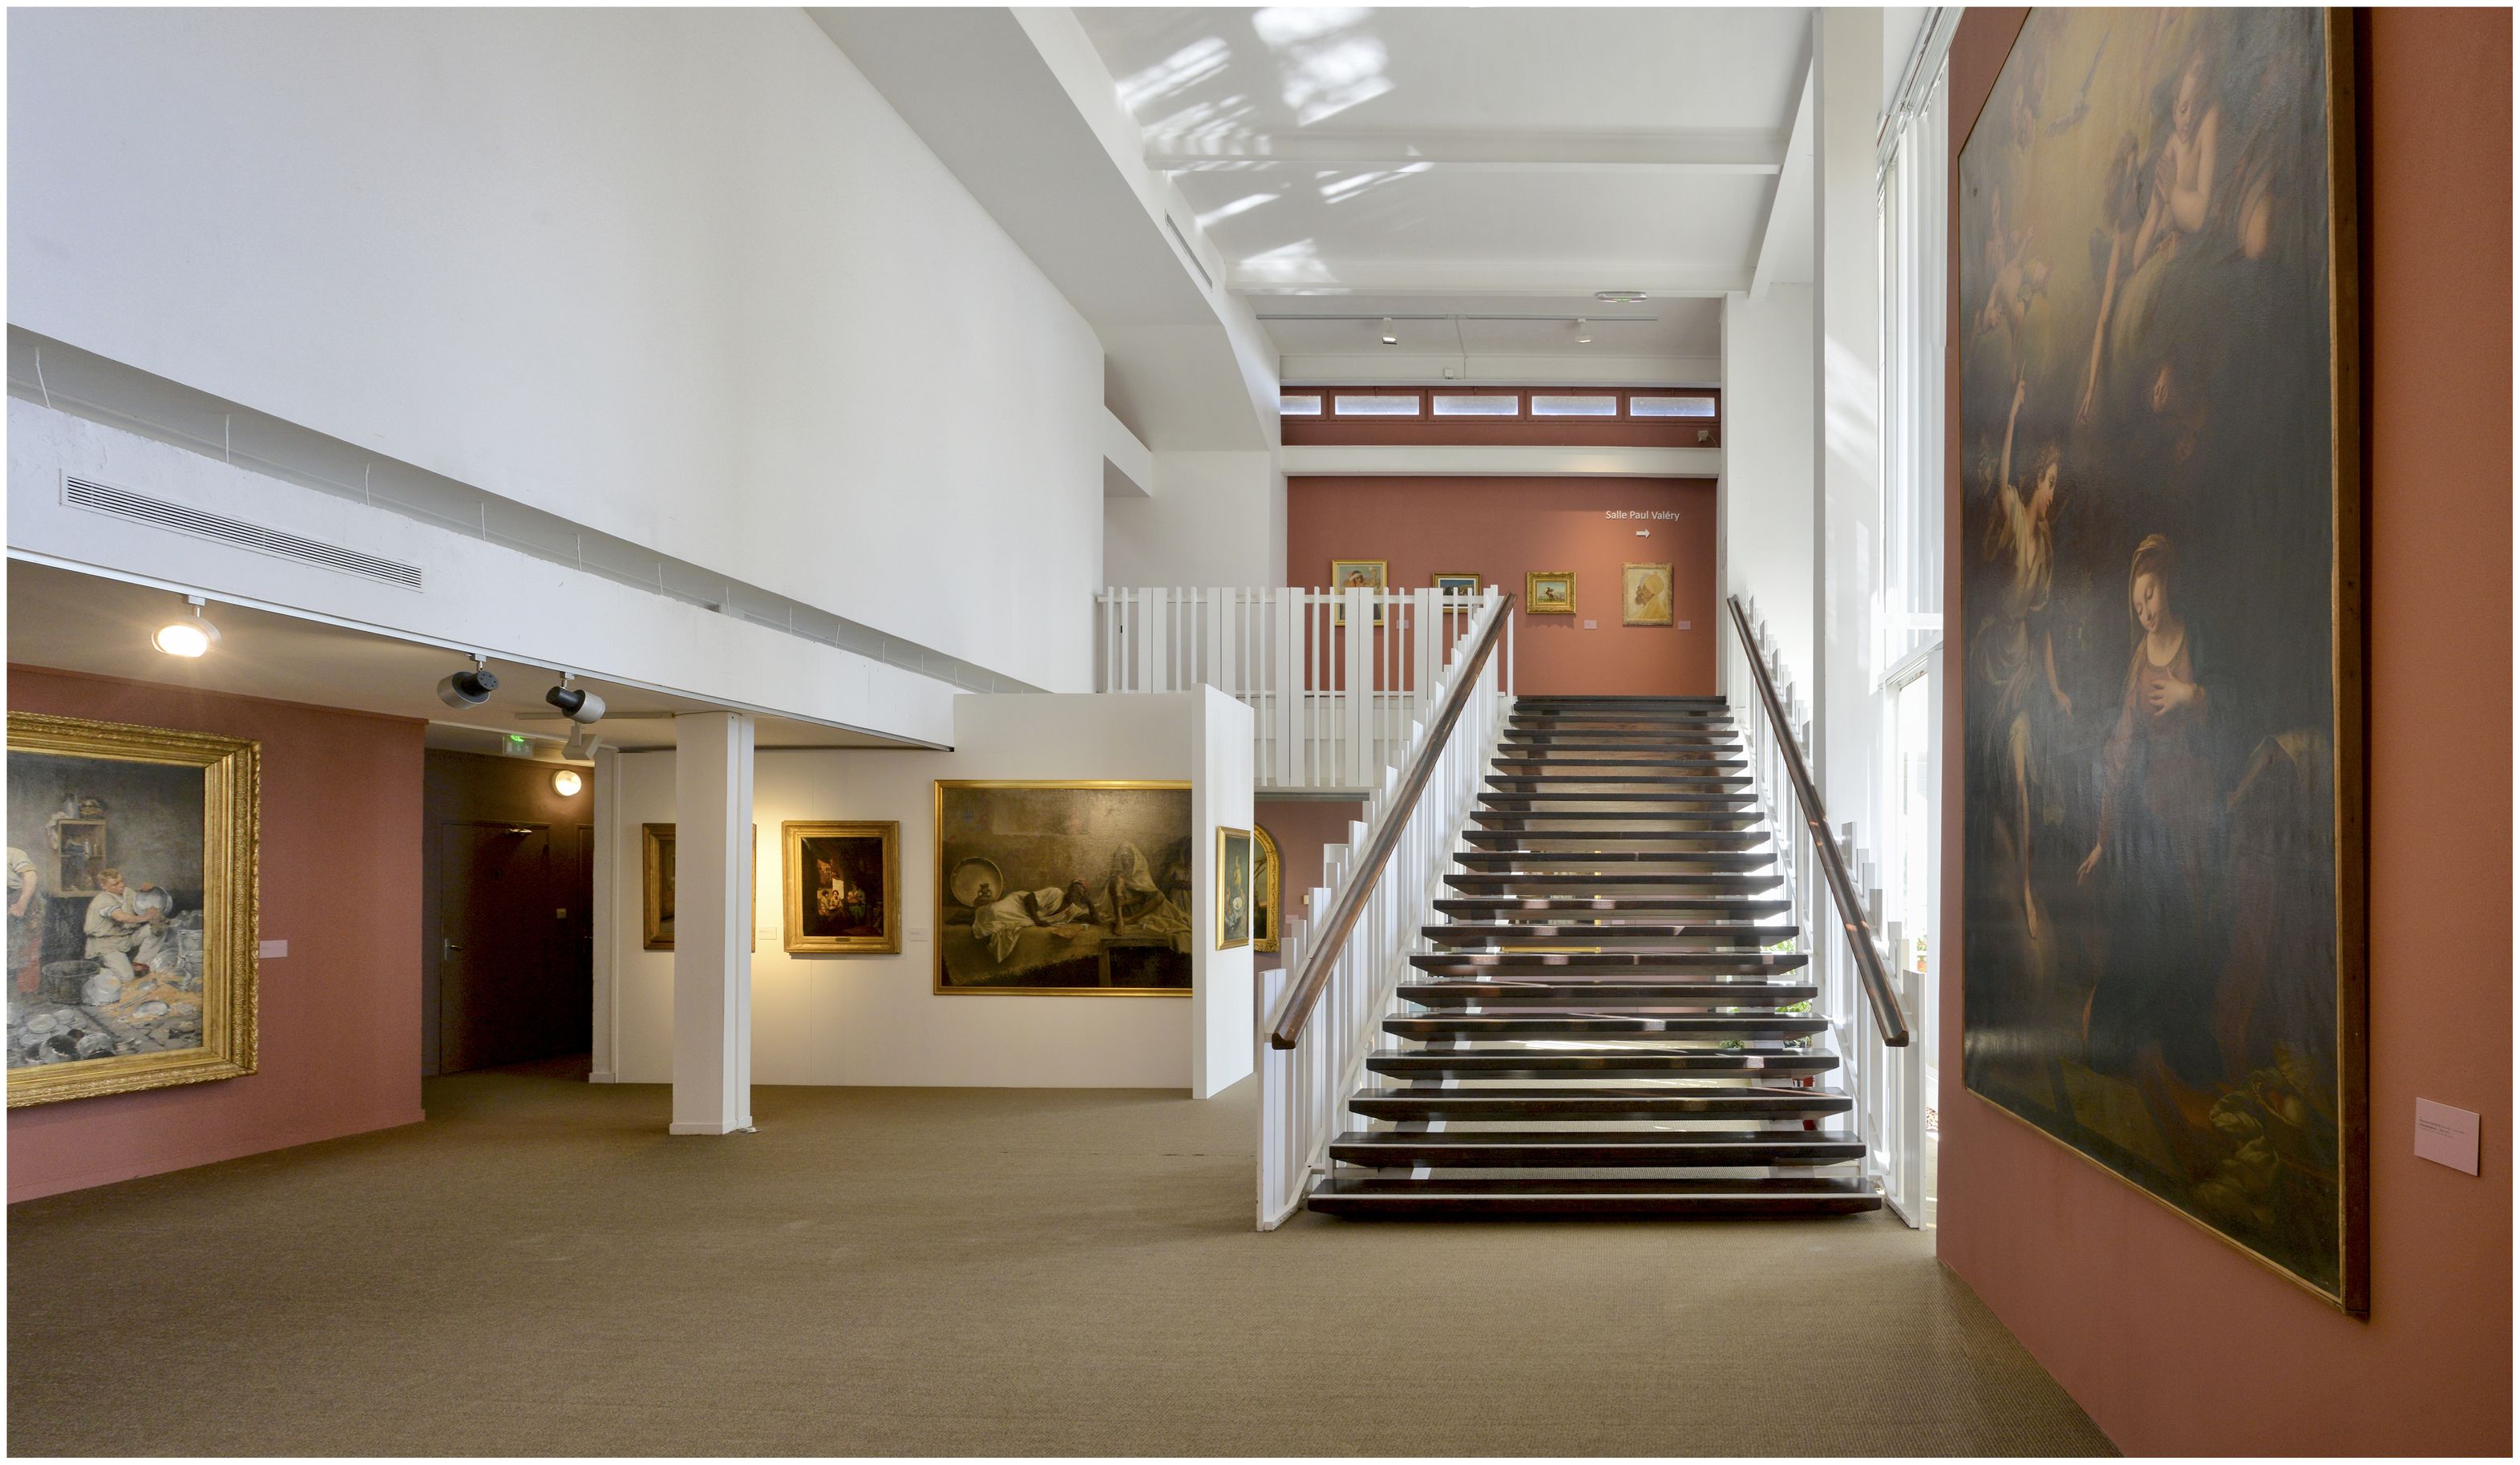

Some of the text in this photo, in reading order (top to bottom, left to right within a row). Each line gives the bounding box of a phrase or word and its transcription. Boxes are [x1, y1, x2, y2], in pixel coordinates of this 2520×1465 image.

[1605, 510, 1681, 522] Salle Paul Valéry
